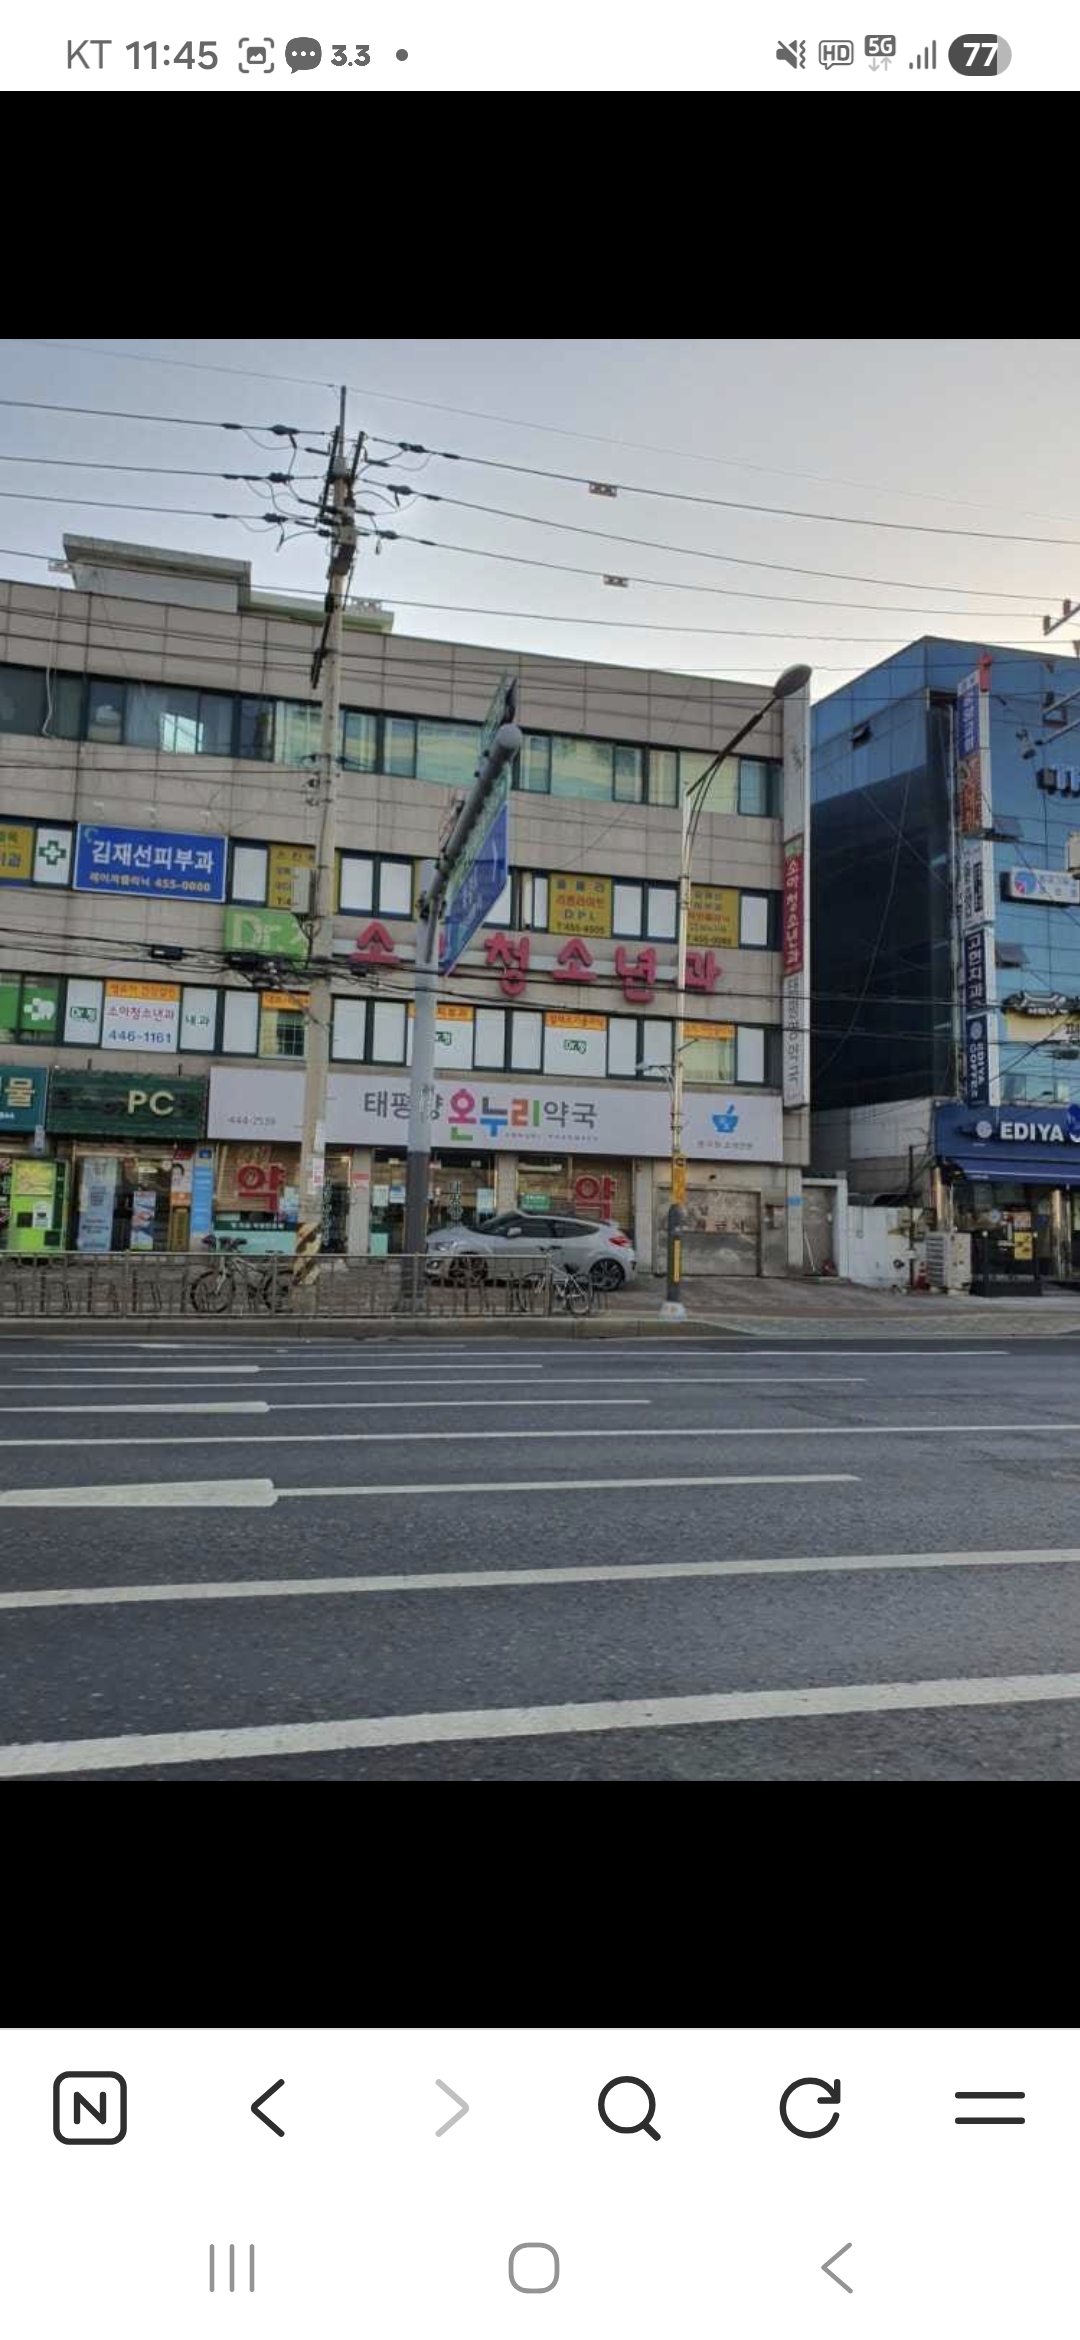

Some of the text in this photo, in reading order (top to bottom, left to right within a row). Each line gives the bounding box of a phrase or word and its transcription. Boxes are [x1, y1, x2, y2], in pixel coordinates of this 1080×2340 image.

[92, 840, 214, 875] 김재선피부과
[348, 920, 723, 1004] 소청소년과
[106, 1006, 174, 1022] 소아청소년과
[109, 1030, 172, 1043] 446-1161
[127, 1089, 174, 1116] PC
[1000, 1121, 1065, 1142] EDIYA
[237, 1162, 287, 1212] 약
[575, 1174, 617, 1220] 약
